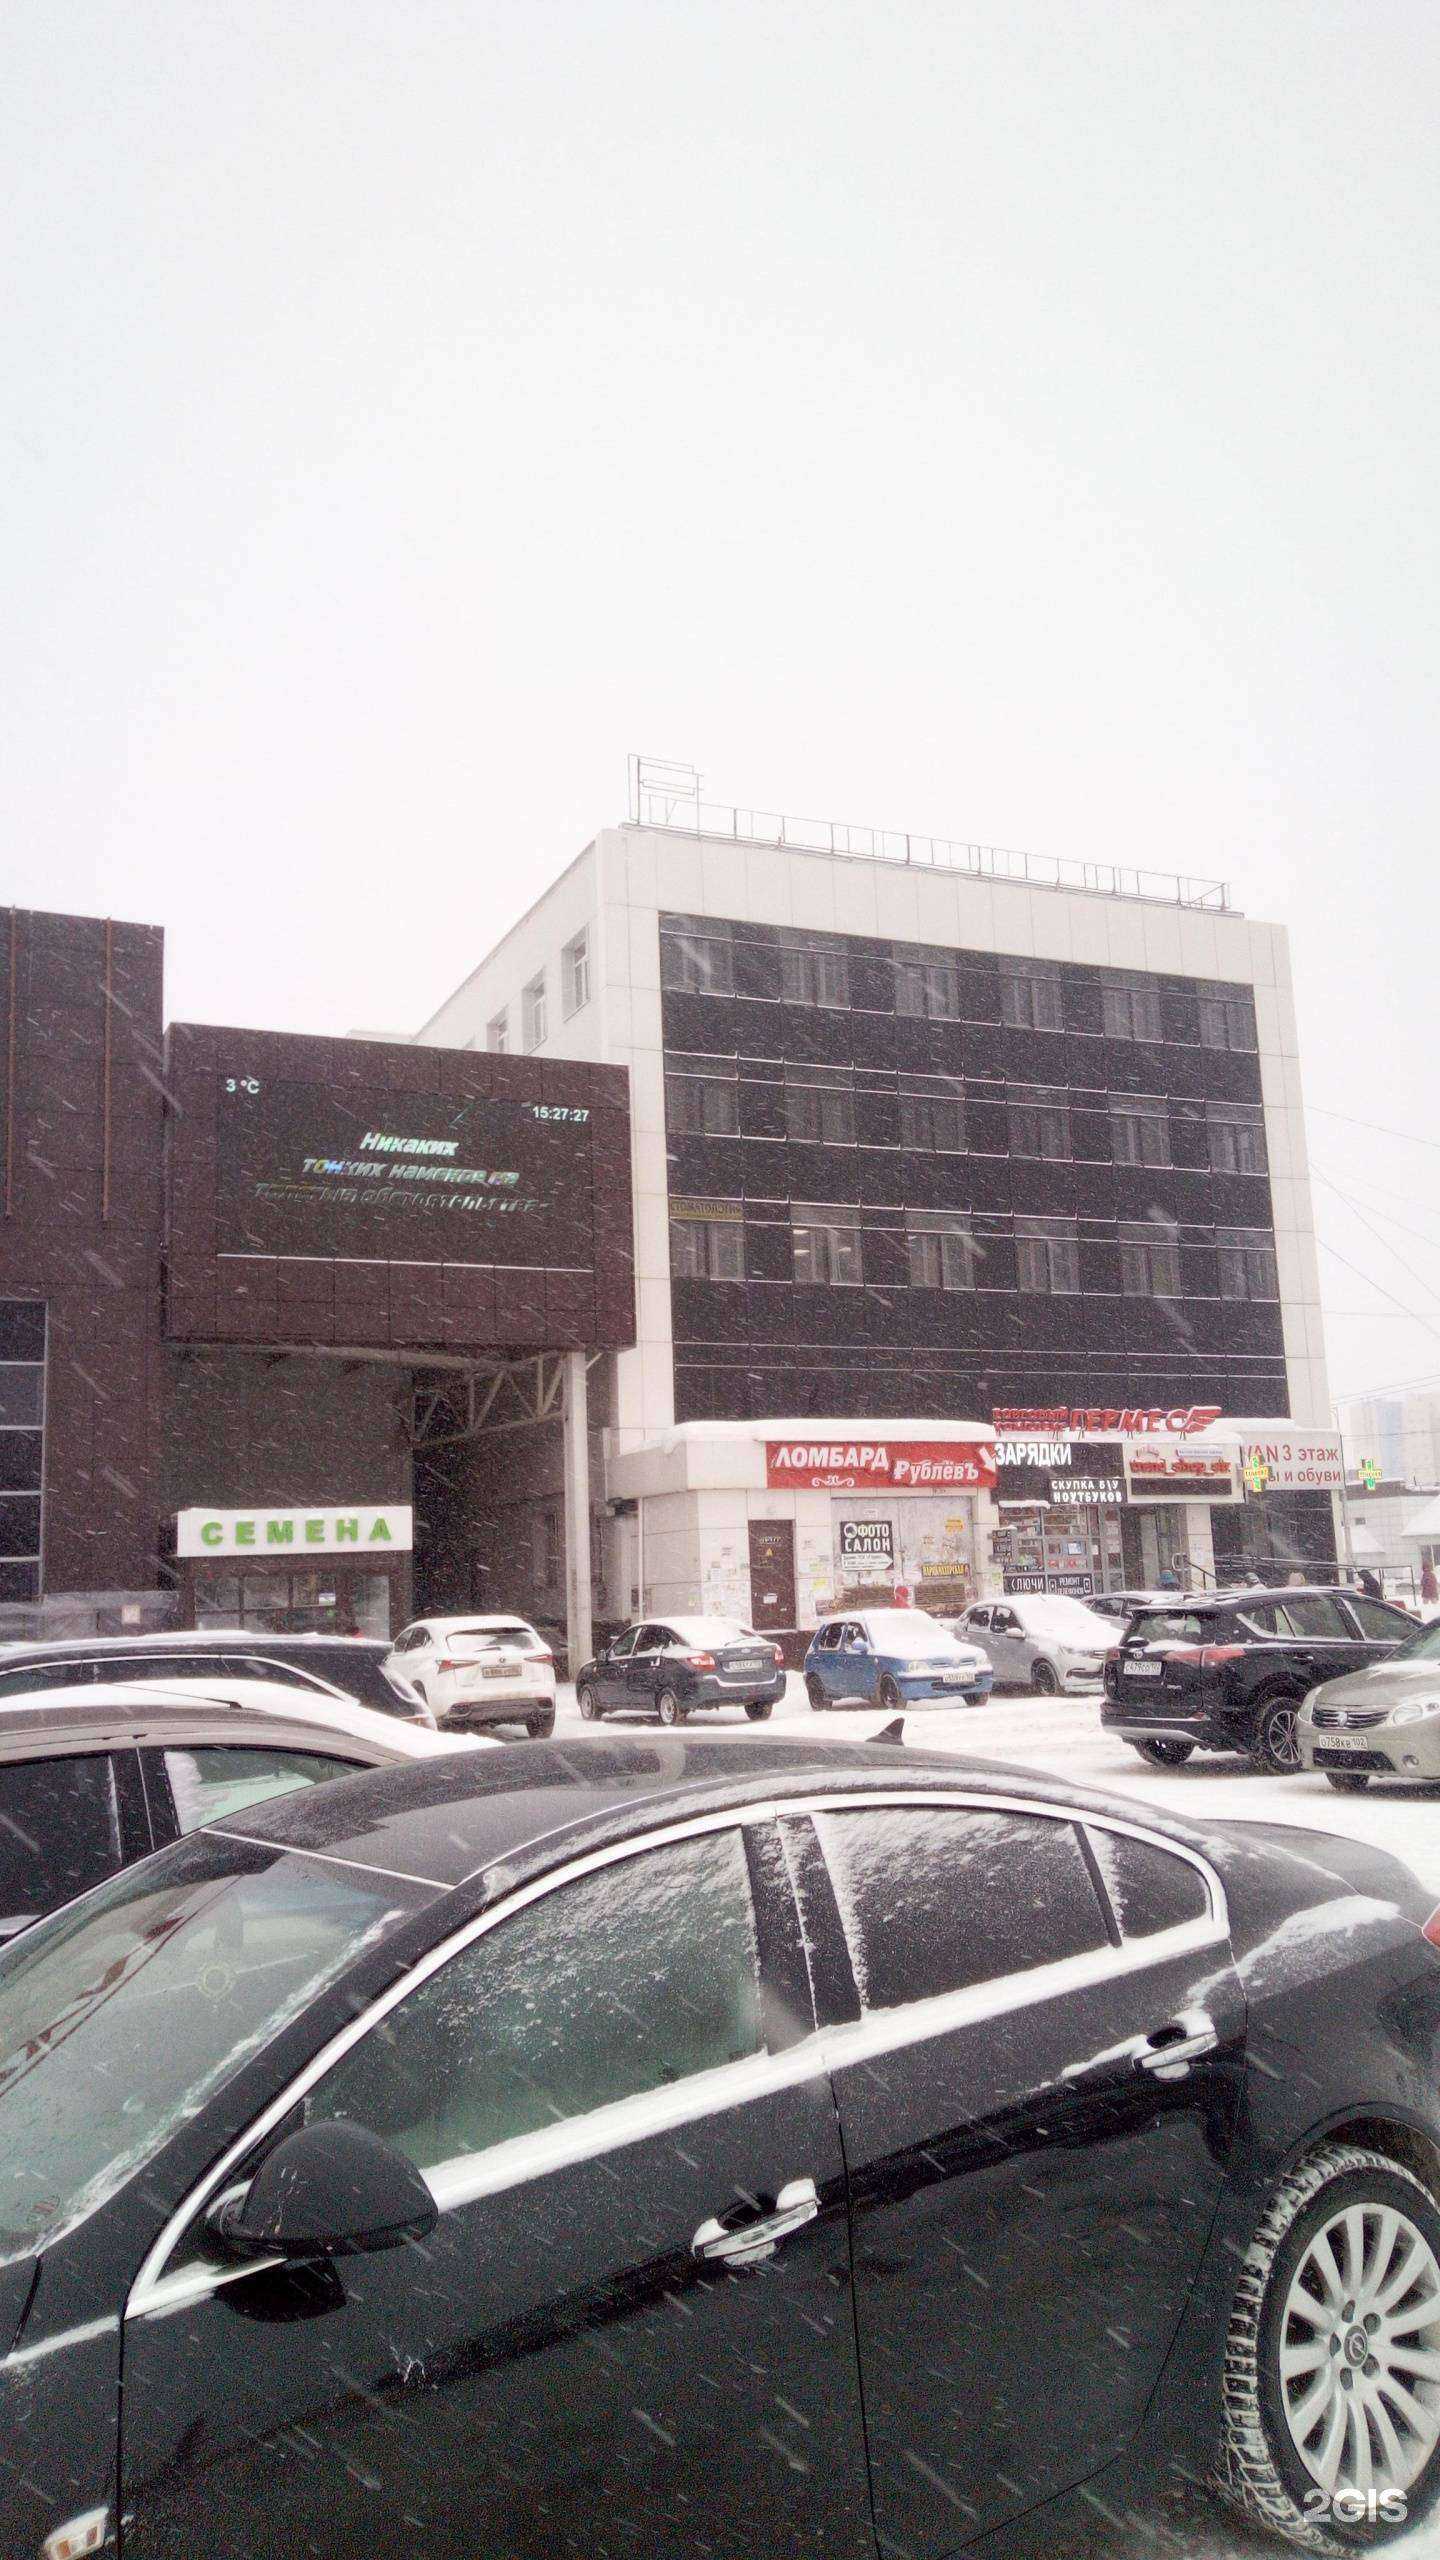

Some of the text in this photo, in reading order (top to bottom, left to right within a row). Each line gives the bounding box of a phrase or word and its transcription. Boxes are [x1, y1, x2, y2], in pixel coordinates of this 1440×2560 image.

[532, 1106, 589, 1122] 15:27:27
[360, 1132, 459, 1156] Никаких
[775, 1447, 889, 1470] ЛОМБАРД
[995, 1443, 1072, 1467] ЗАРЯДКИ
[1282, 1445, 1293, 1461] 3
[1298, 1449, 1339, 1461] этаж
[1298, 1468, 1341, 1485] обуви
[1051, 1480, 1095, 1491] СКУПКА
[1053, 1491, 1123, 1503] НОУТБУКОВ
[201, 1518, 392, 1546] СЕМЕНА
[857, 1524, 890, 1537] ФОТО
[844, 1537, 891, 1552] САЛОН
